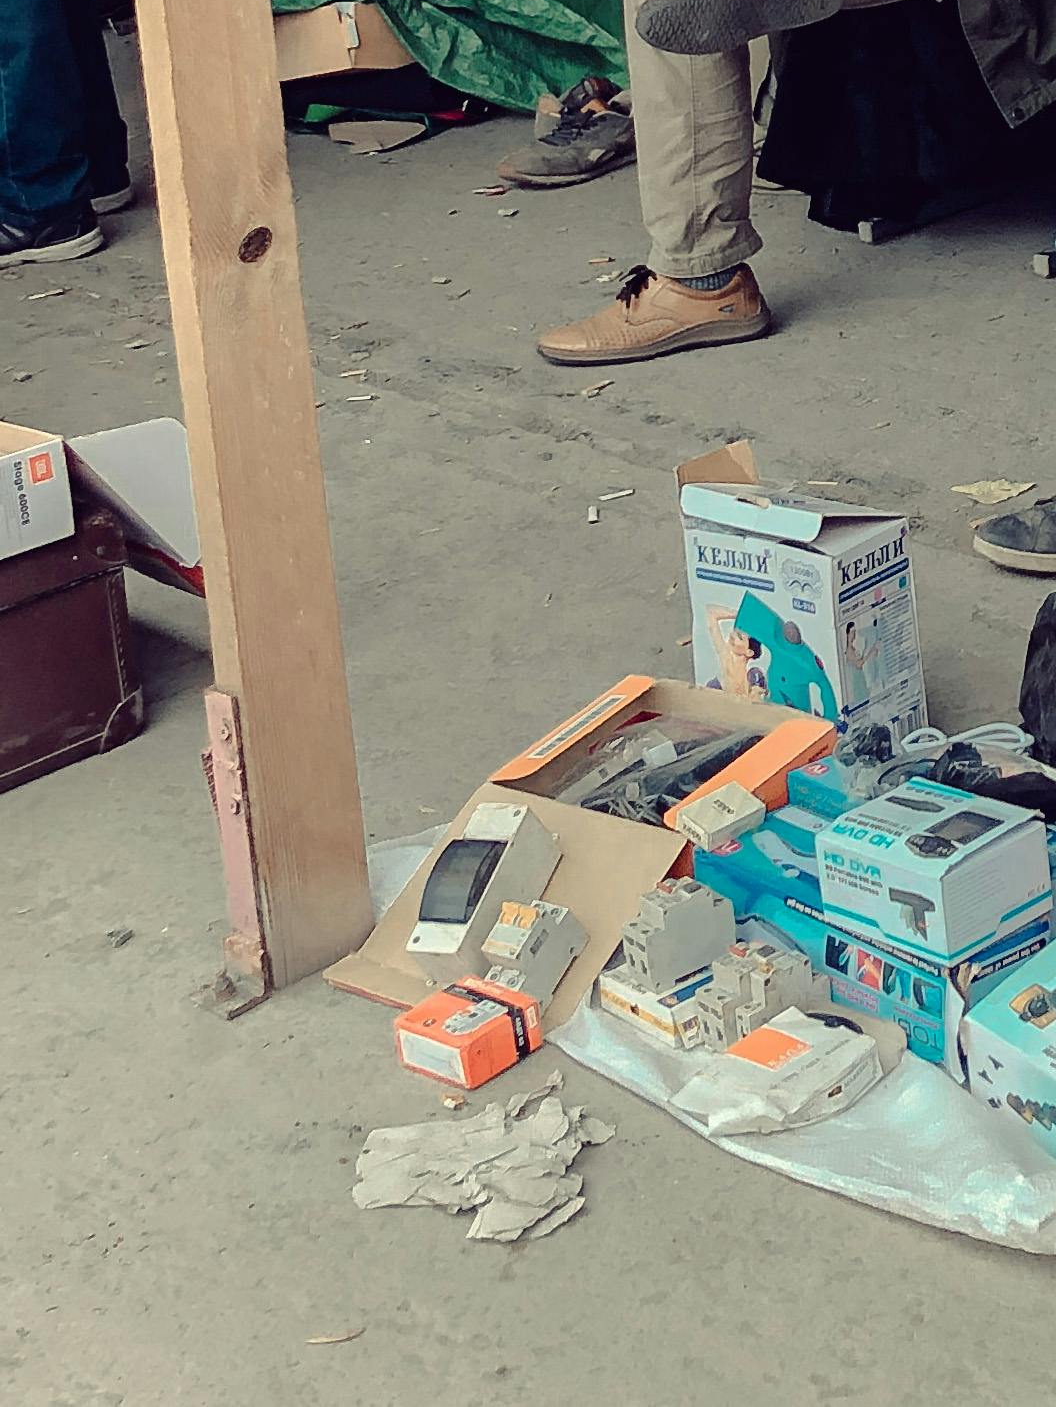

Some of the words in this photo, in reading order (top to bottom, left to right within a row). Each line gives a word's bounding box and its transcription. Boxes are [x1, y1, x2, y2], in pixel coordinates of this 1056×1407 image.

[13, 461, 24, 491] Stage
[696, 544, 769, 574] КЕЛЛИ
[840, 537, 905, 586] КЕЛЛИ
